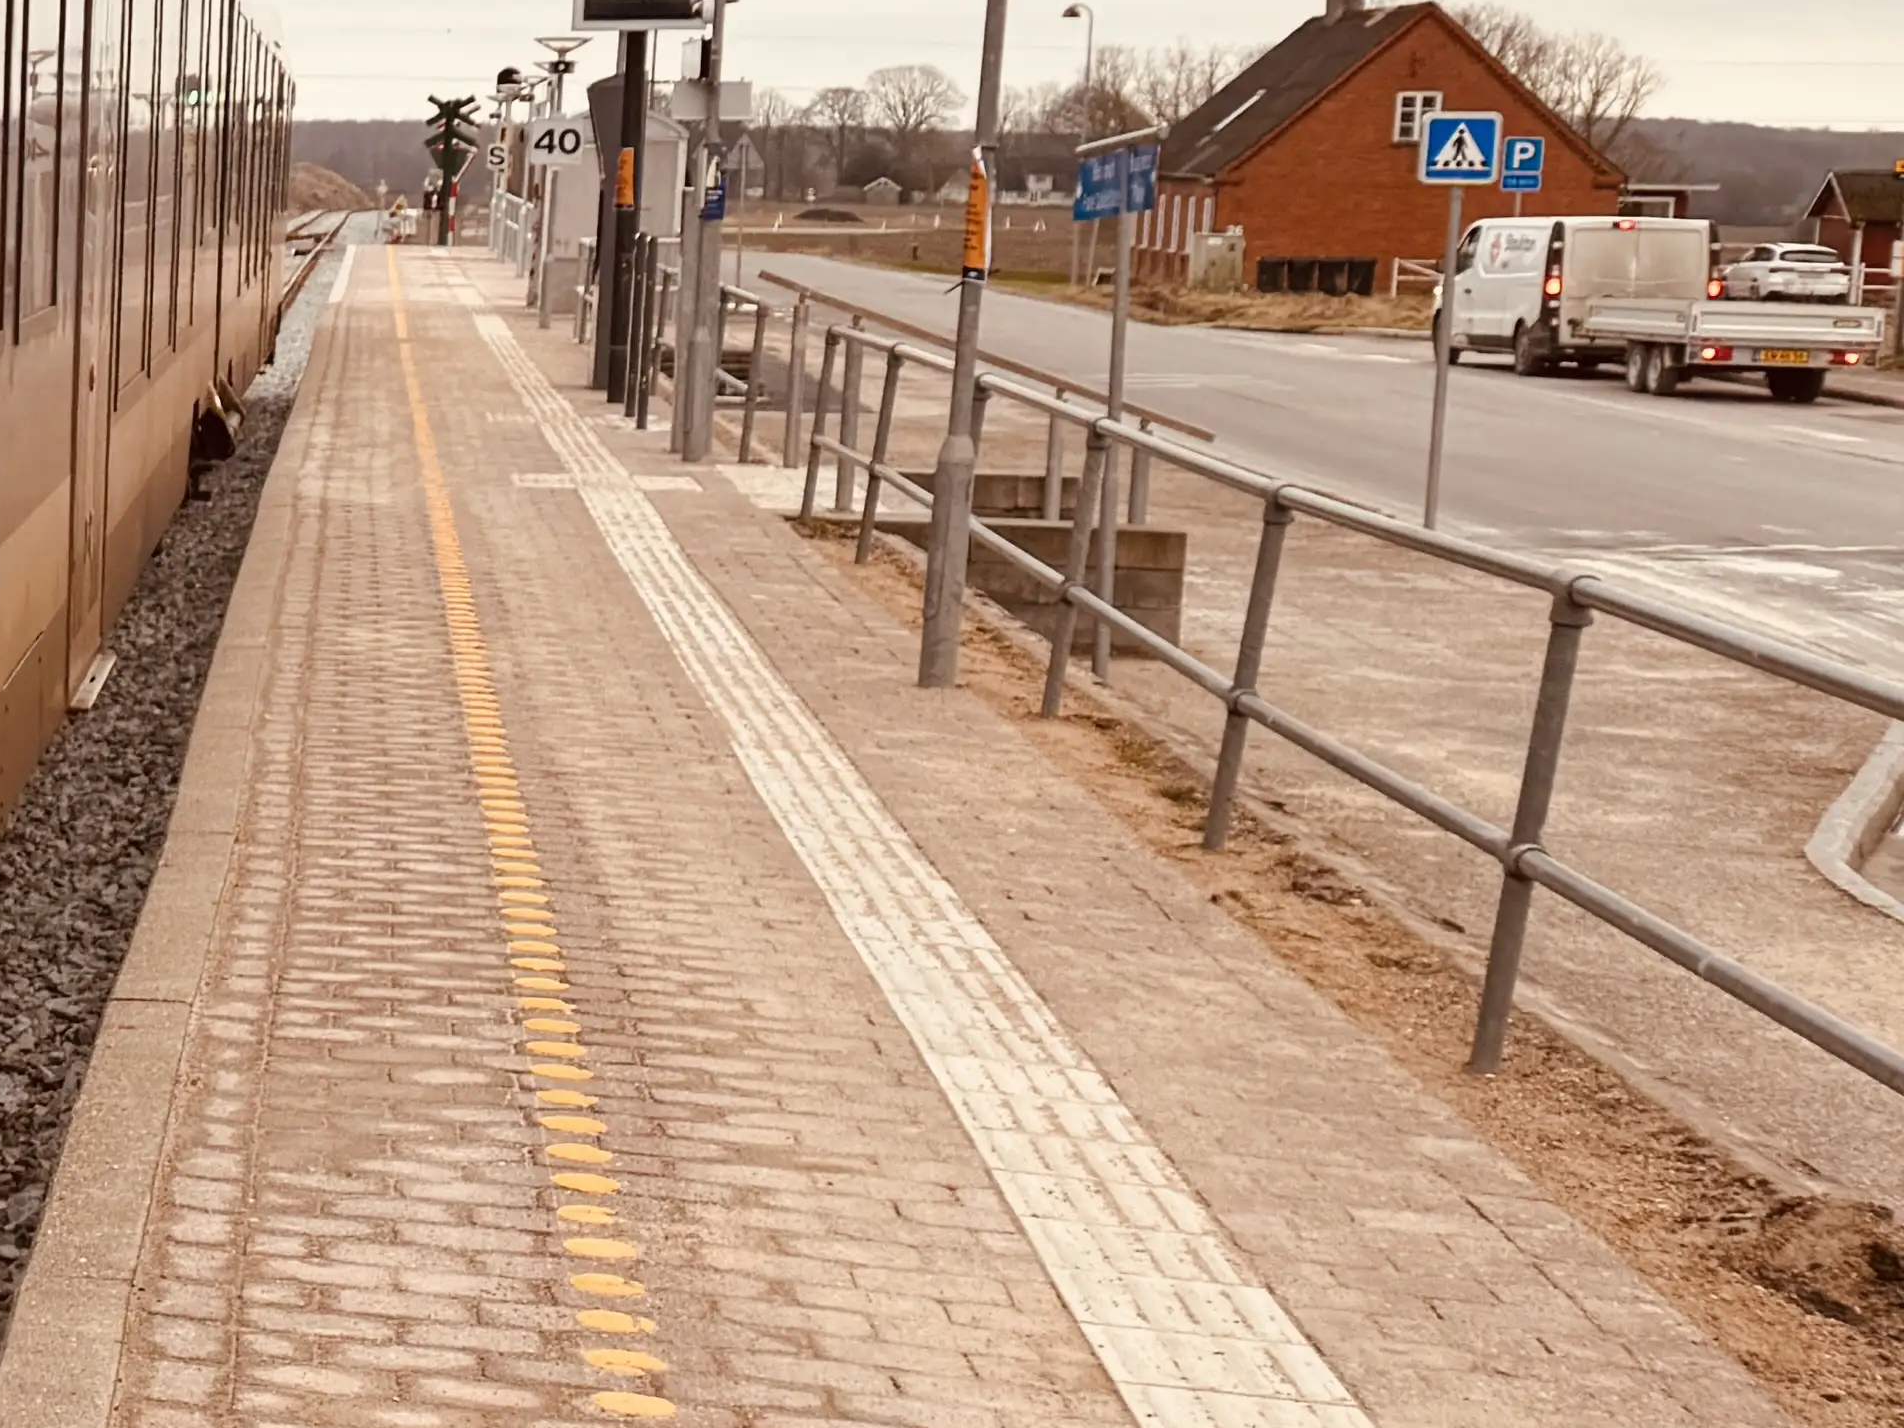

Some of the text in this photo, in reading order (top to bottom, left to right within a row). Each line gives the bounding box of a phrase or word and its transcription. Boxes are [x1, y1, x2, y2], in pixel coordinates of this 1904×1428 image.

[533, 128, 581, 154] 40
[489, 146, 505, 165] S
[1512, 141, 1535, 168] P
